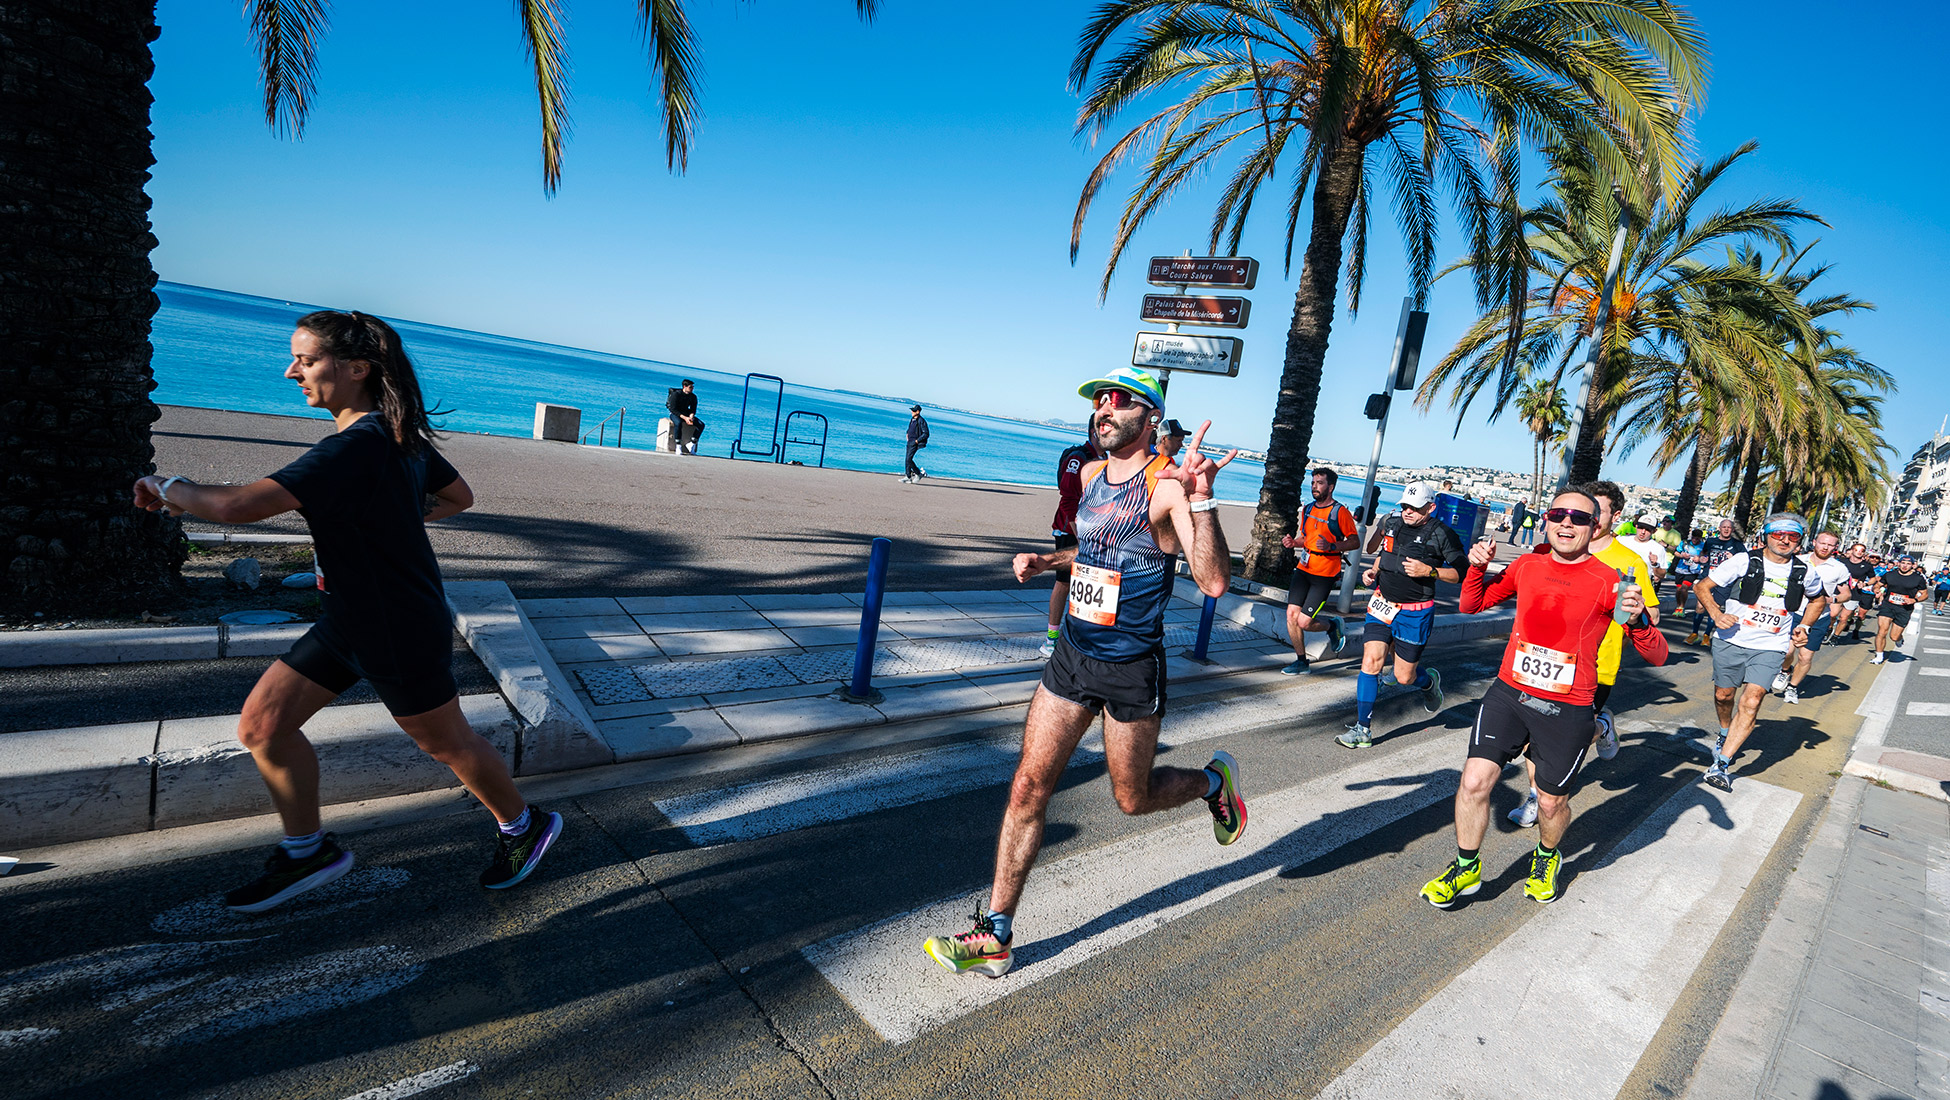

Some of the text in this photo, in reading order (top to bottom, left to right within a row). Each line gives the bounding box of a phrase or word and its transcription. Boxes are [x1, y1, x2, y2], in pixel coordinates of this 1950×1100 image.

[1171, 262, 1195, 270] Marché
[1212, 263, 1234, 271] Fleurs
[1169, 271, 1213, 280] Cours Saleya
[1155, 300, 1196, 309] Palais Ducal
[1153, 309, 1177, 317] Chapelle
[1190, 310, 1224, 319] Miséricorde
[1171, 349, 1177, 357] la
[1177, 350, 1214, 360] photographie
[1076, 565, 1090, 574] NICE
[1071, 579, 1104, 608] 4984
[1371, 599, 1392, 615] 6076
[1751, 611, 1781, 626] 2379
[1532, 646, 1549, 654] NICE
[1521, 656, 1564, 680] 6337
